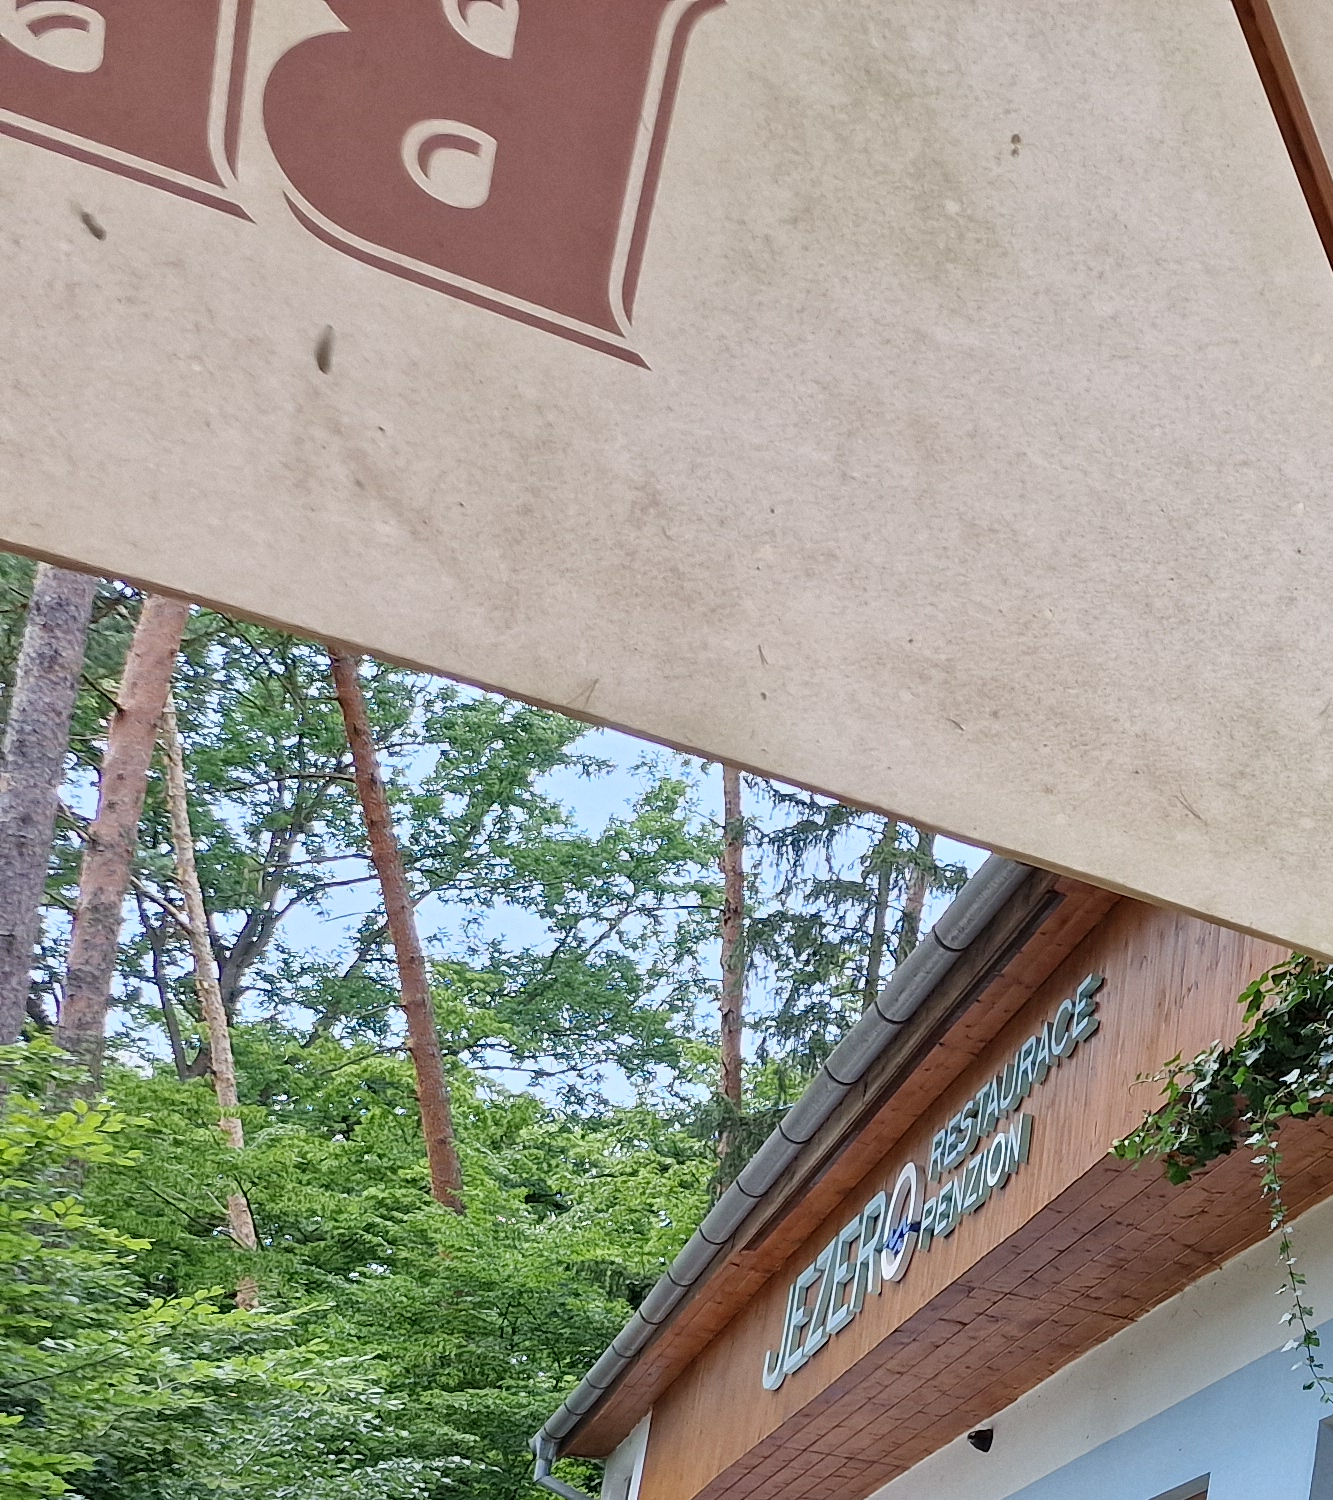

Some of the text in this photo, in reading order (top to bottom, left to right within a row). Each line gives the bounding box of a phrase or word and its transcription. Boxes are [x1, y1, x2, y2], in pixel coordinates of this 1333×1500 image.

[928, 972, 1104, 1181] RESTAURACE
[762, 1162, 925, 1390] JEZERO
[918, 1113, 1033, 1250] PENZION
